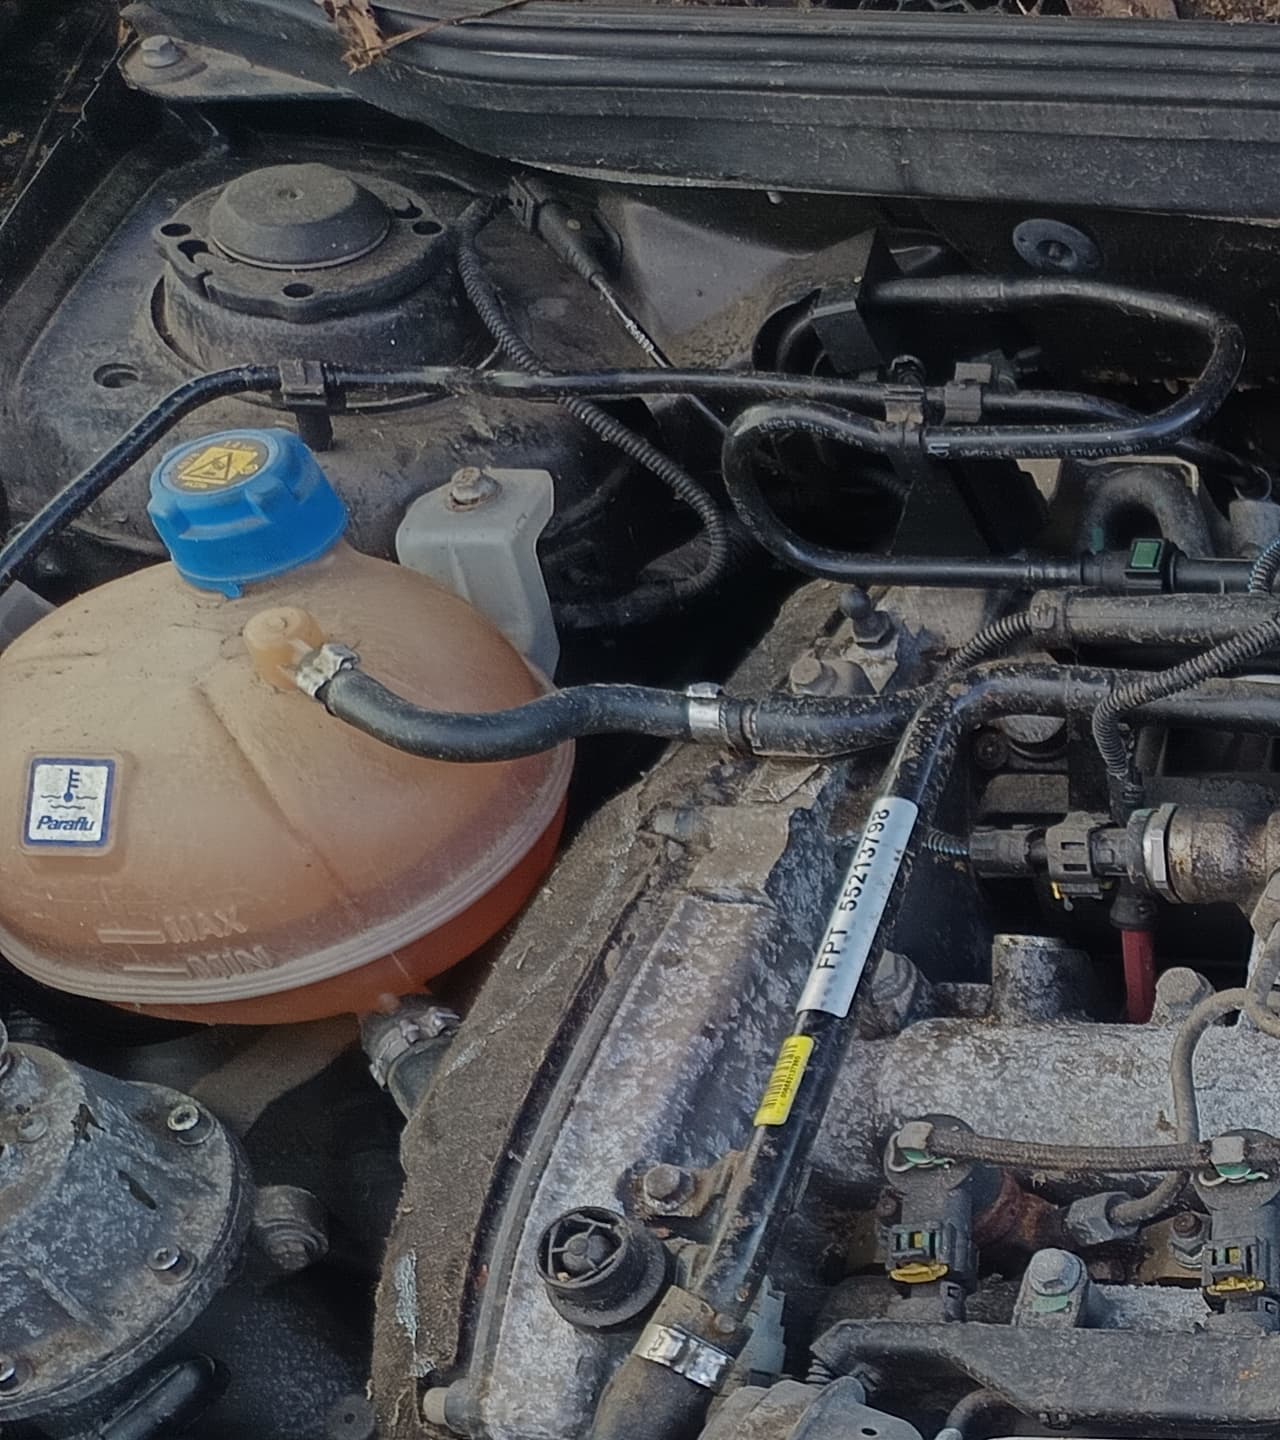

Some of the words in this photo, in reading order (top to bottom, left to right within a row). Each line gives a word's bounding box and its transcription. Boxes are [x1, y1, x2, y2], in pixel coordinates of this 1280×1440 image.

[36, 815, 95, 832] Paraflu
[817, 927, 848, 970] FPT
[839, 808, 890, 912] 55213798
